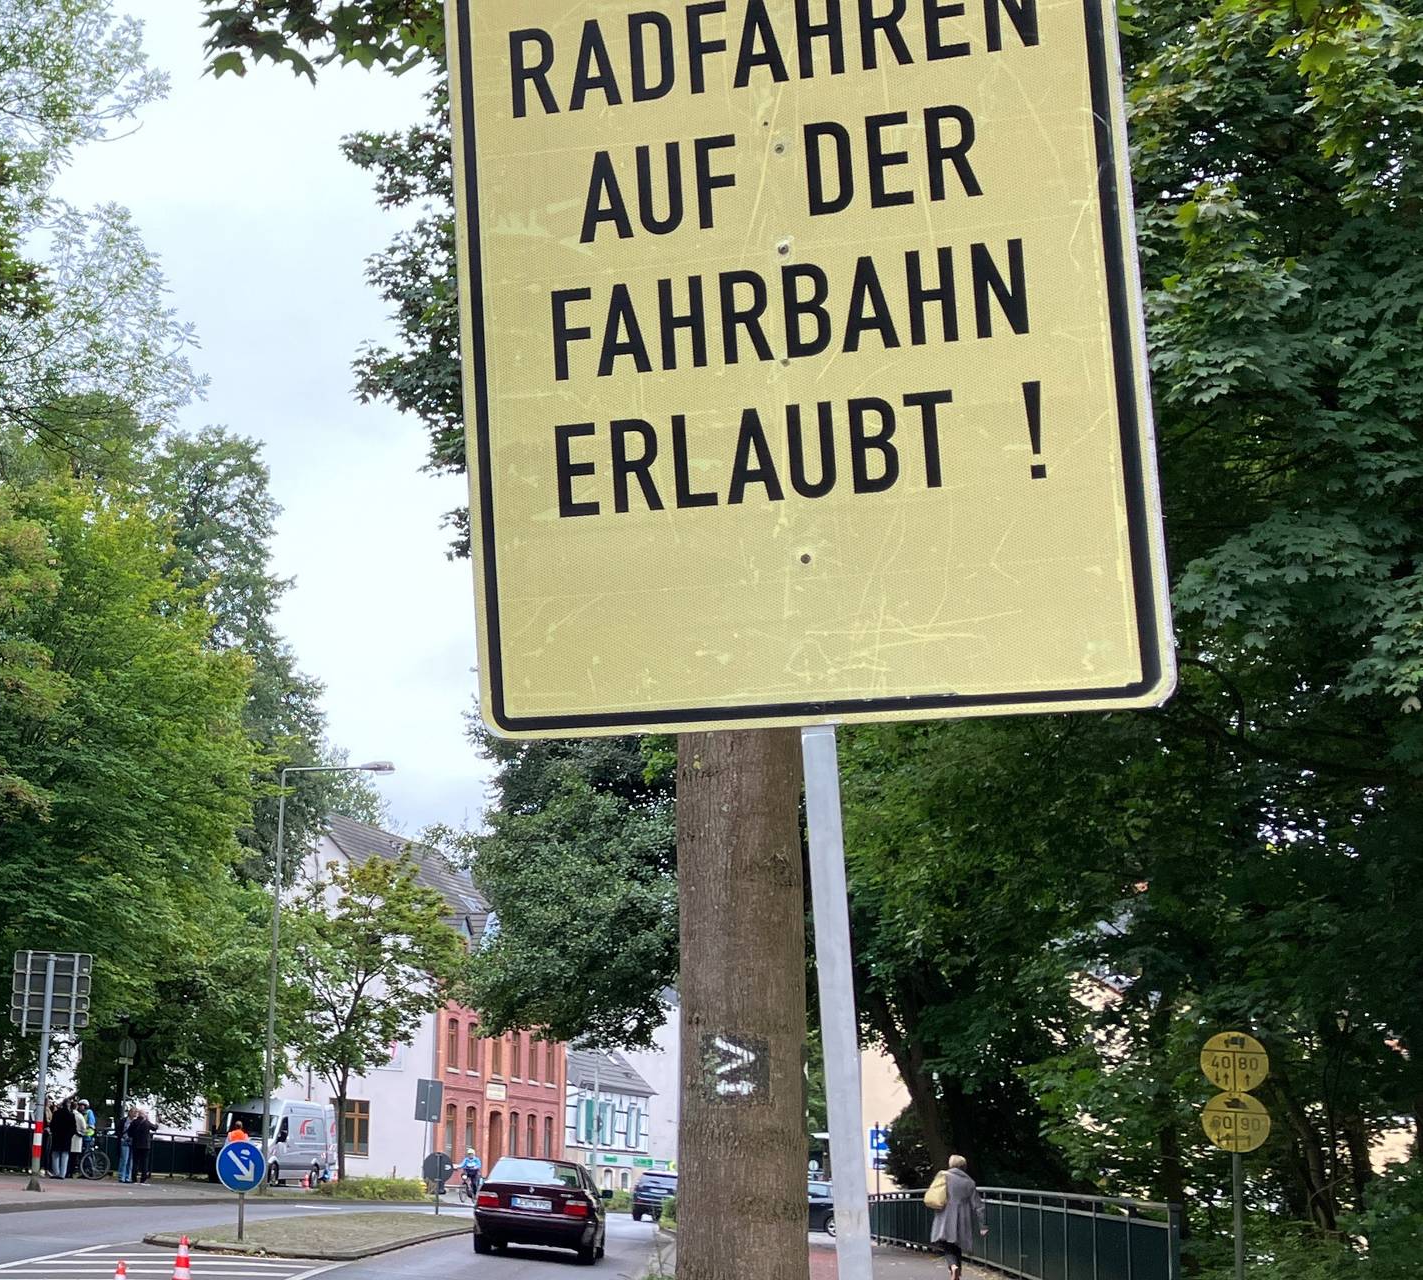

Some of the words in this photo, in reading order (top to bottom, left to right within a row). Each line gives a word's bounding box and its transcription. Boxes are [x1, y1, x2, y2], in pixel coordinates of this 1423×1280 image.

[508, 0, 1040, 118] RADFAHREN
[579, 134, 736, 244] AUF
[803, 105, 984, 217] DER
[550, 238, 1030, 381] FAHRBAHN
[554, 389, 953, 518] ERLAUBT
[1021, 380, 1047, 480] !
[1211, 1055, 1231, 1069] 40
[1238, 1057, 1259, 1070] 80
[1240, 1117, 1261, 1131] 90
